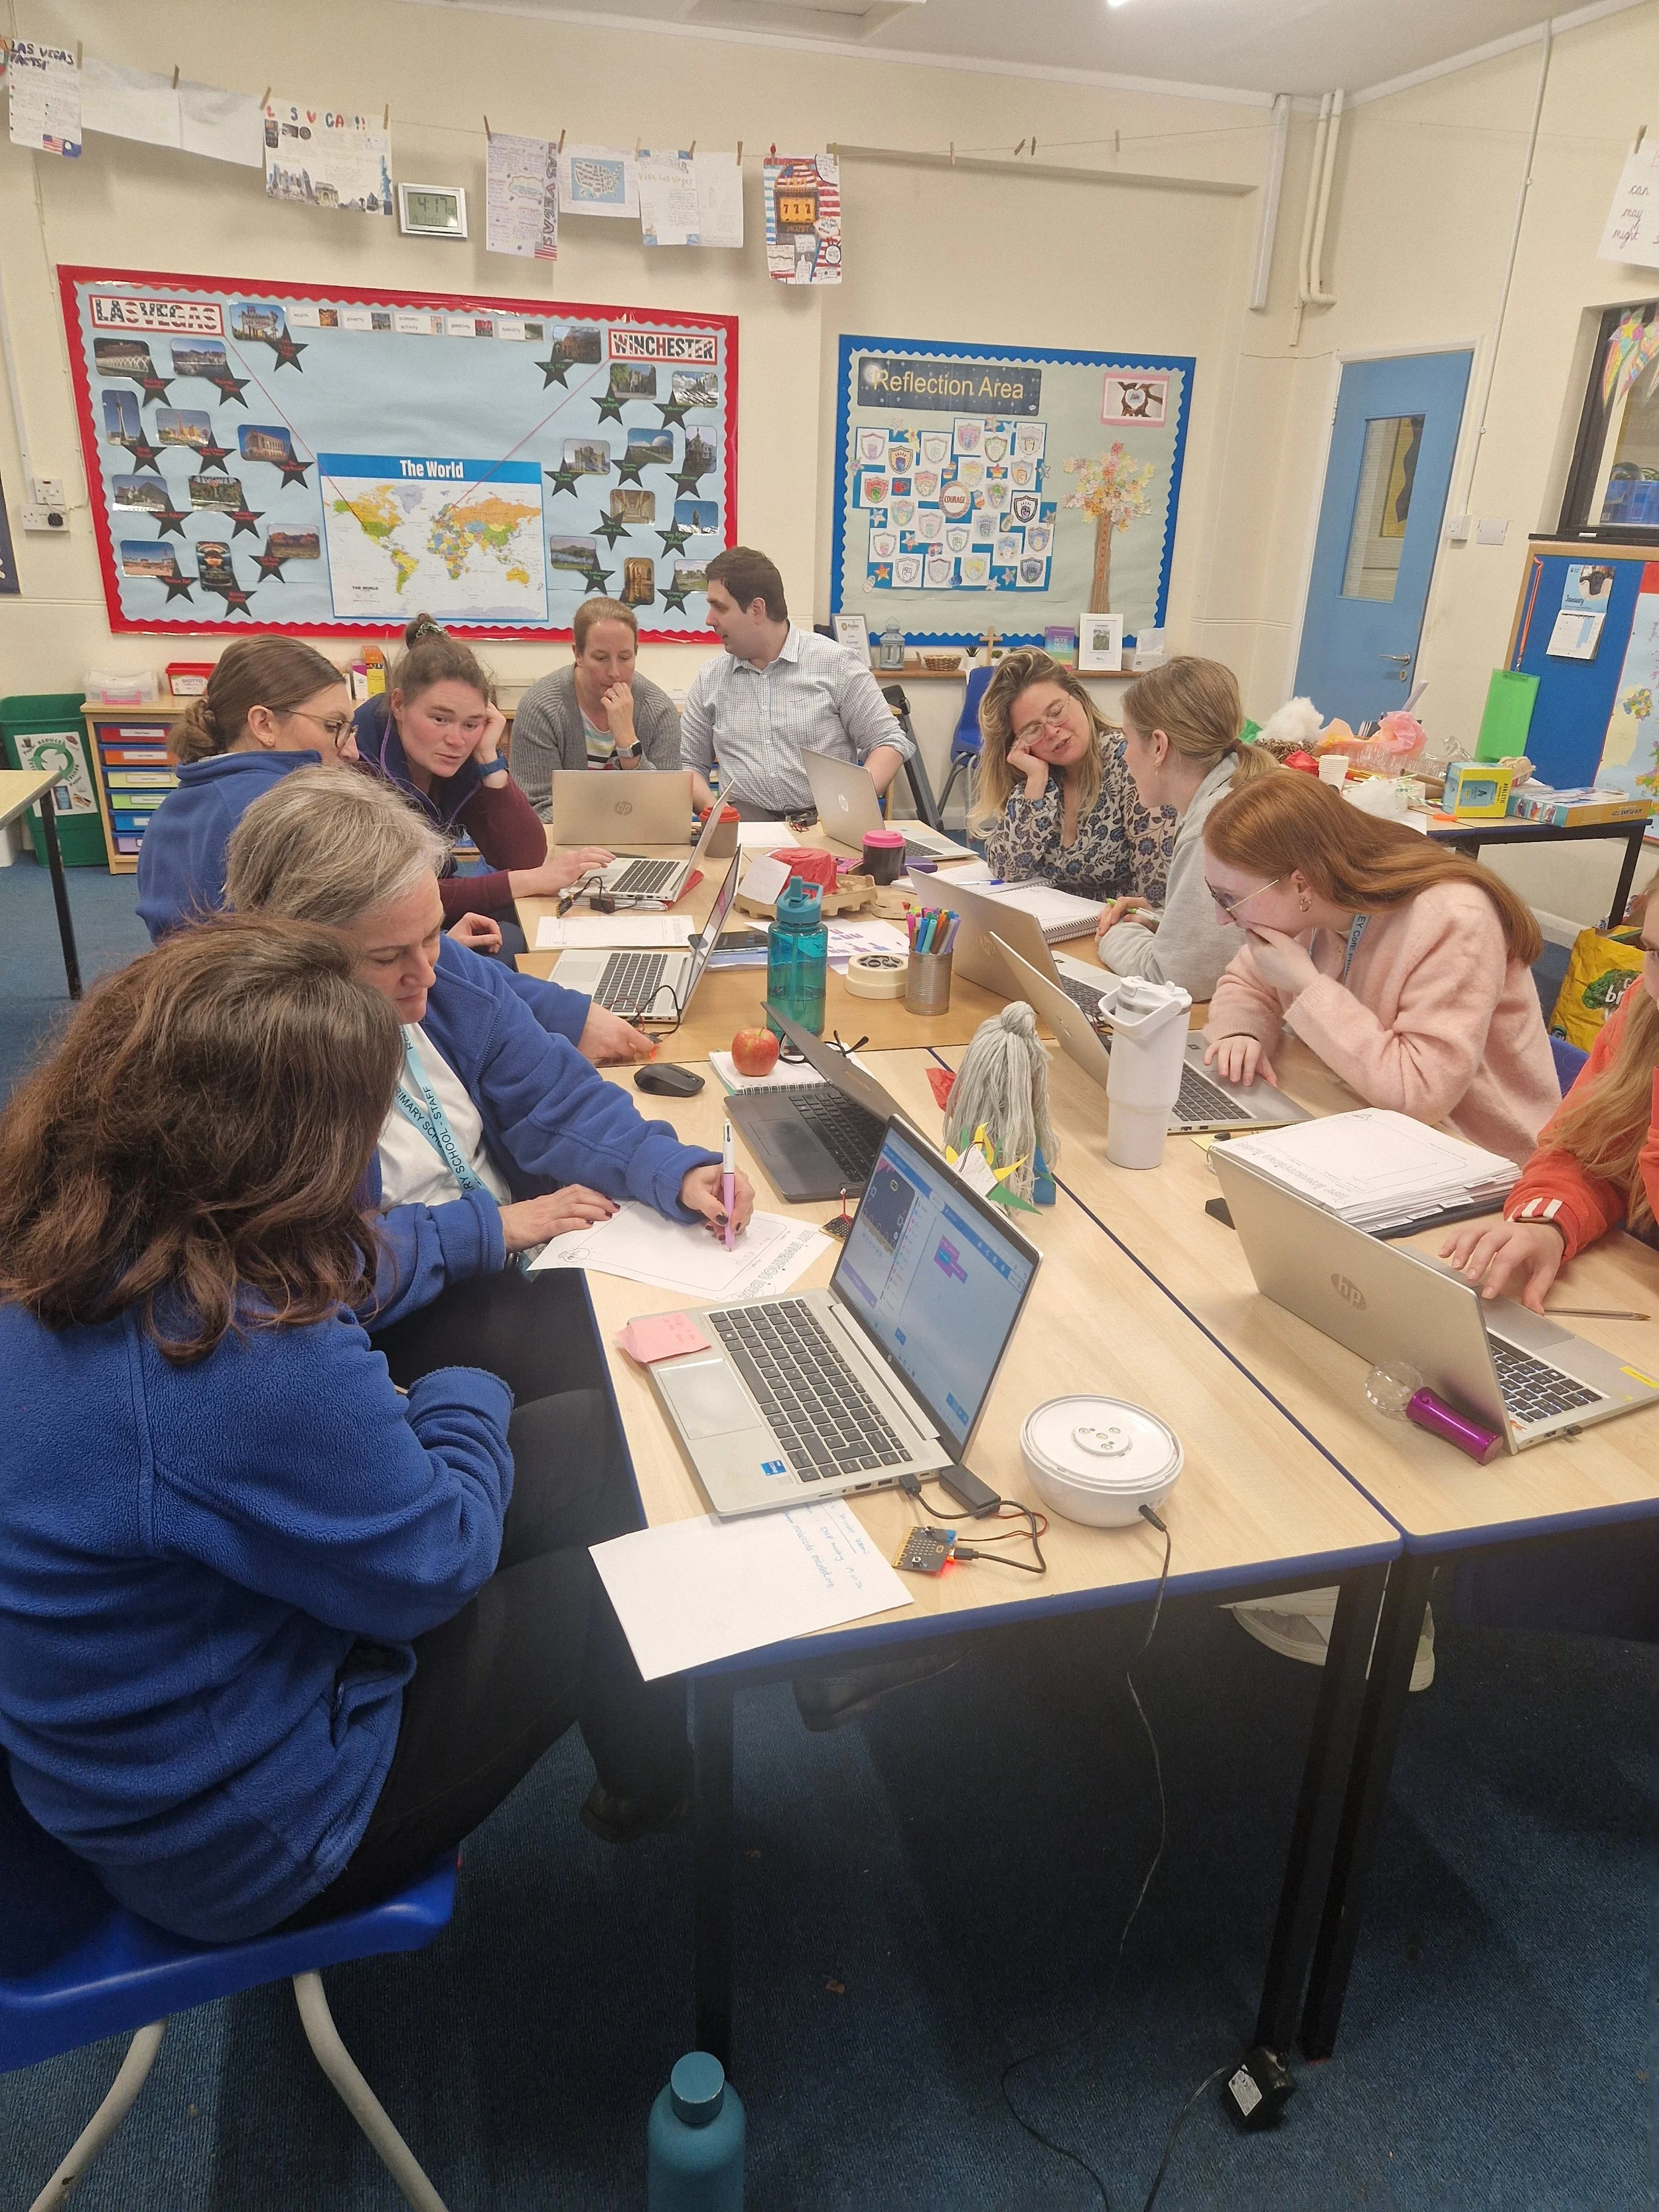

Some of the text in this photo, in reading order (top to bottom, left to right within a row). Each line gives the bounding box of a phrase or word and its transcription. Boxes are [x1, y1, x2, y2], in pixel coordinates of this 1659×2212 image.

[11, 40, 34, 54] LAS
[1629, 184, 1650, 196] can
[1621, 208, 1644, 229] may
[1613, 224, 1639, 249] might
[613, 334, 713, 359] WINCHESTER
[873, 369, 1024, 399] Reflection Area
[399, 460, 464, 479] The World
[944, 495, 966, 504] COURAGE
[1565, 595, 1585, 606] January
[1500, 782, 1508, 804] ATHLETIC
[422, 1085, 443, 1120] STAFF
[439, 1128, 466, 1174] SCHOOL
